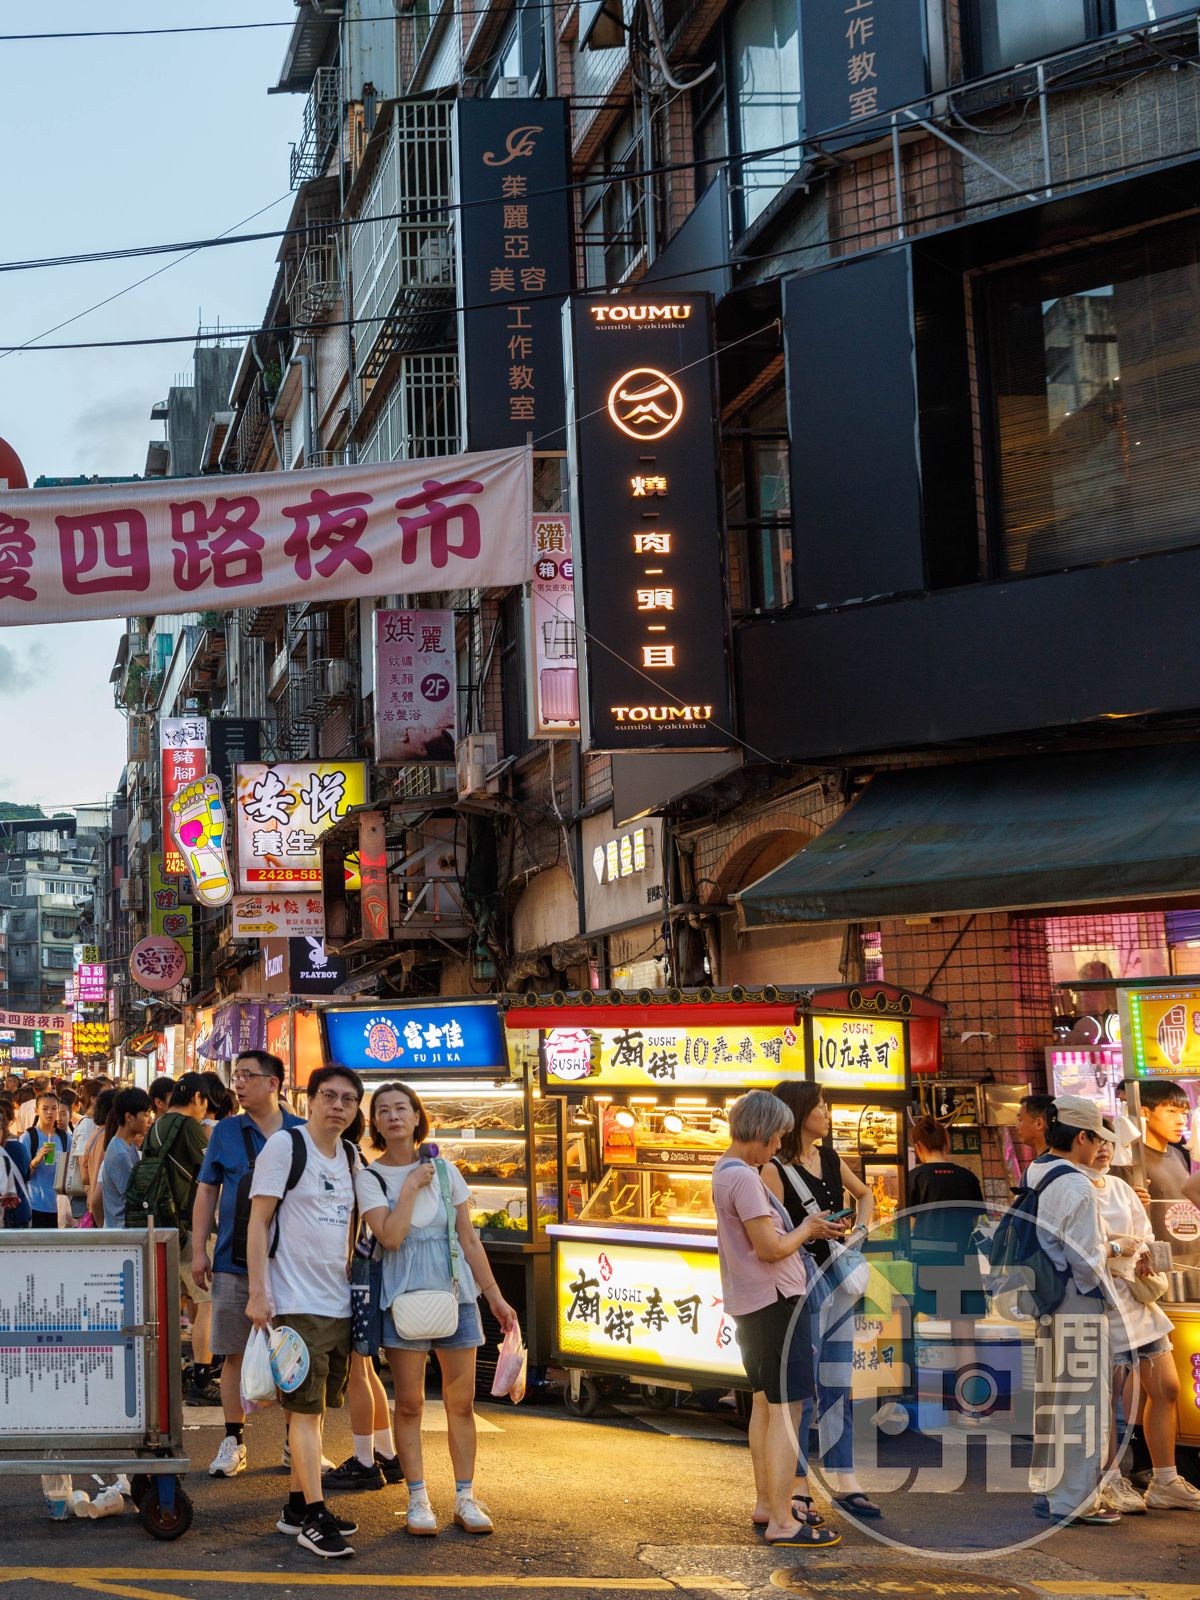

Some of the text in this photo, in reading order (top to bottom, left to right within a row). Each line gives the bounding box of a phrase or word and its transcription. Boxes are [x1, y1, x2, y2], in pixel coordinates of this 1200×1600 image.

[591, 305, 691, 321] TOUMU
[637, 322, 685, 331] yakiniku
[425, 678, 445, 697] 2F
[611, 705, 712, 721] TOUMU
[300, 971, 338, 979] PLAYBOY
[403, 1019, 465, 1049] 富士佳
[842, 1022, 874, 1035] SUSHI
[648, 1036, 676, 1047] SUSHI
[414, 1053, 461, 1063] FU JI KA
[552, 1058, 587, 1071] SUSHI
[607, 1286, 642, 1303] SUSHI
